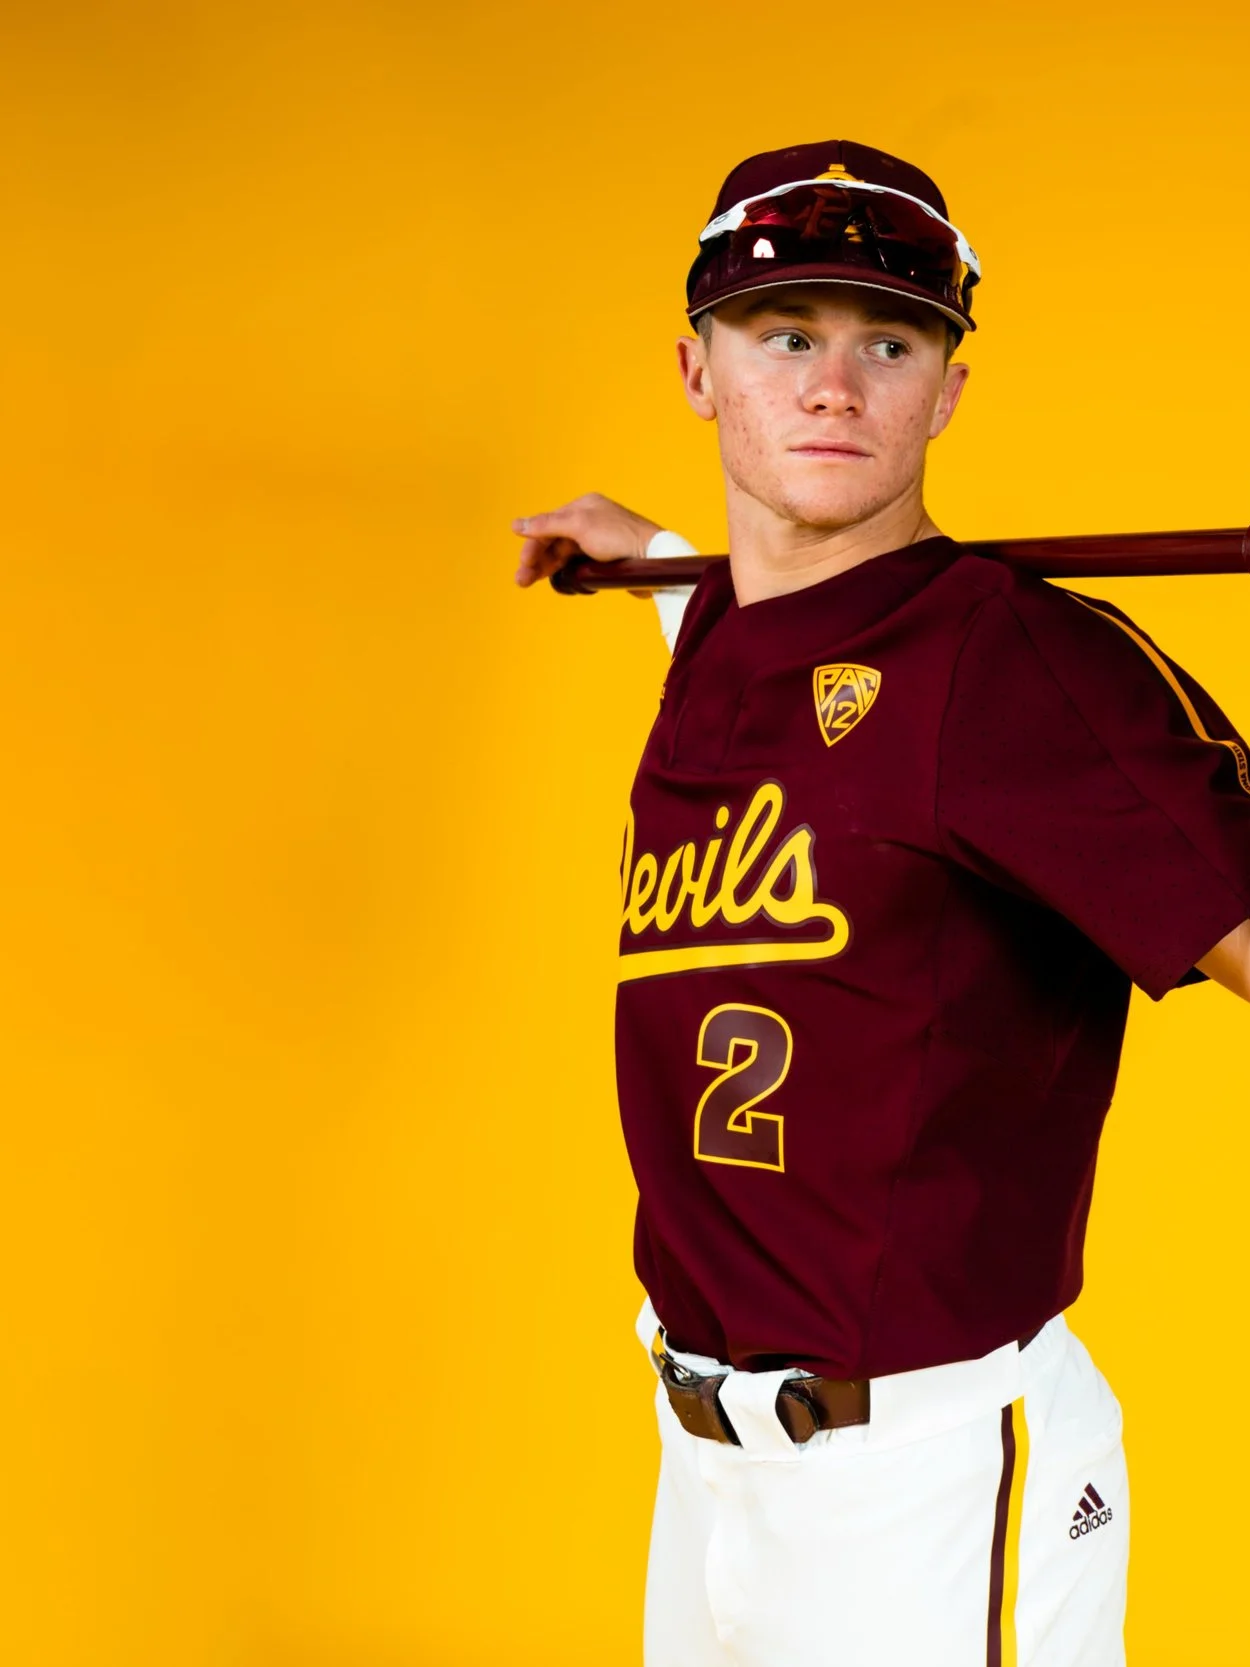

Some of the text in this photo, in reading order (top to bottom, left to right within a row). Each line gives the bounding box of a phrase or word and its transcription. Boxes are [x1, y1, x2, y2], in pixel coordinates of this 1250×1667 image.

[819, 668, 877, 714] PAC
[824, 700, 858, 729] 12
[694, 1002, 793, 1173] 2
[1069, 1507, 1113, 1540] adidas
